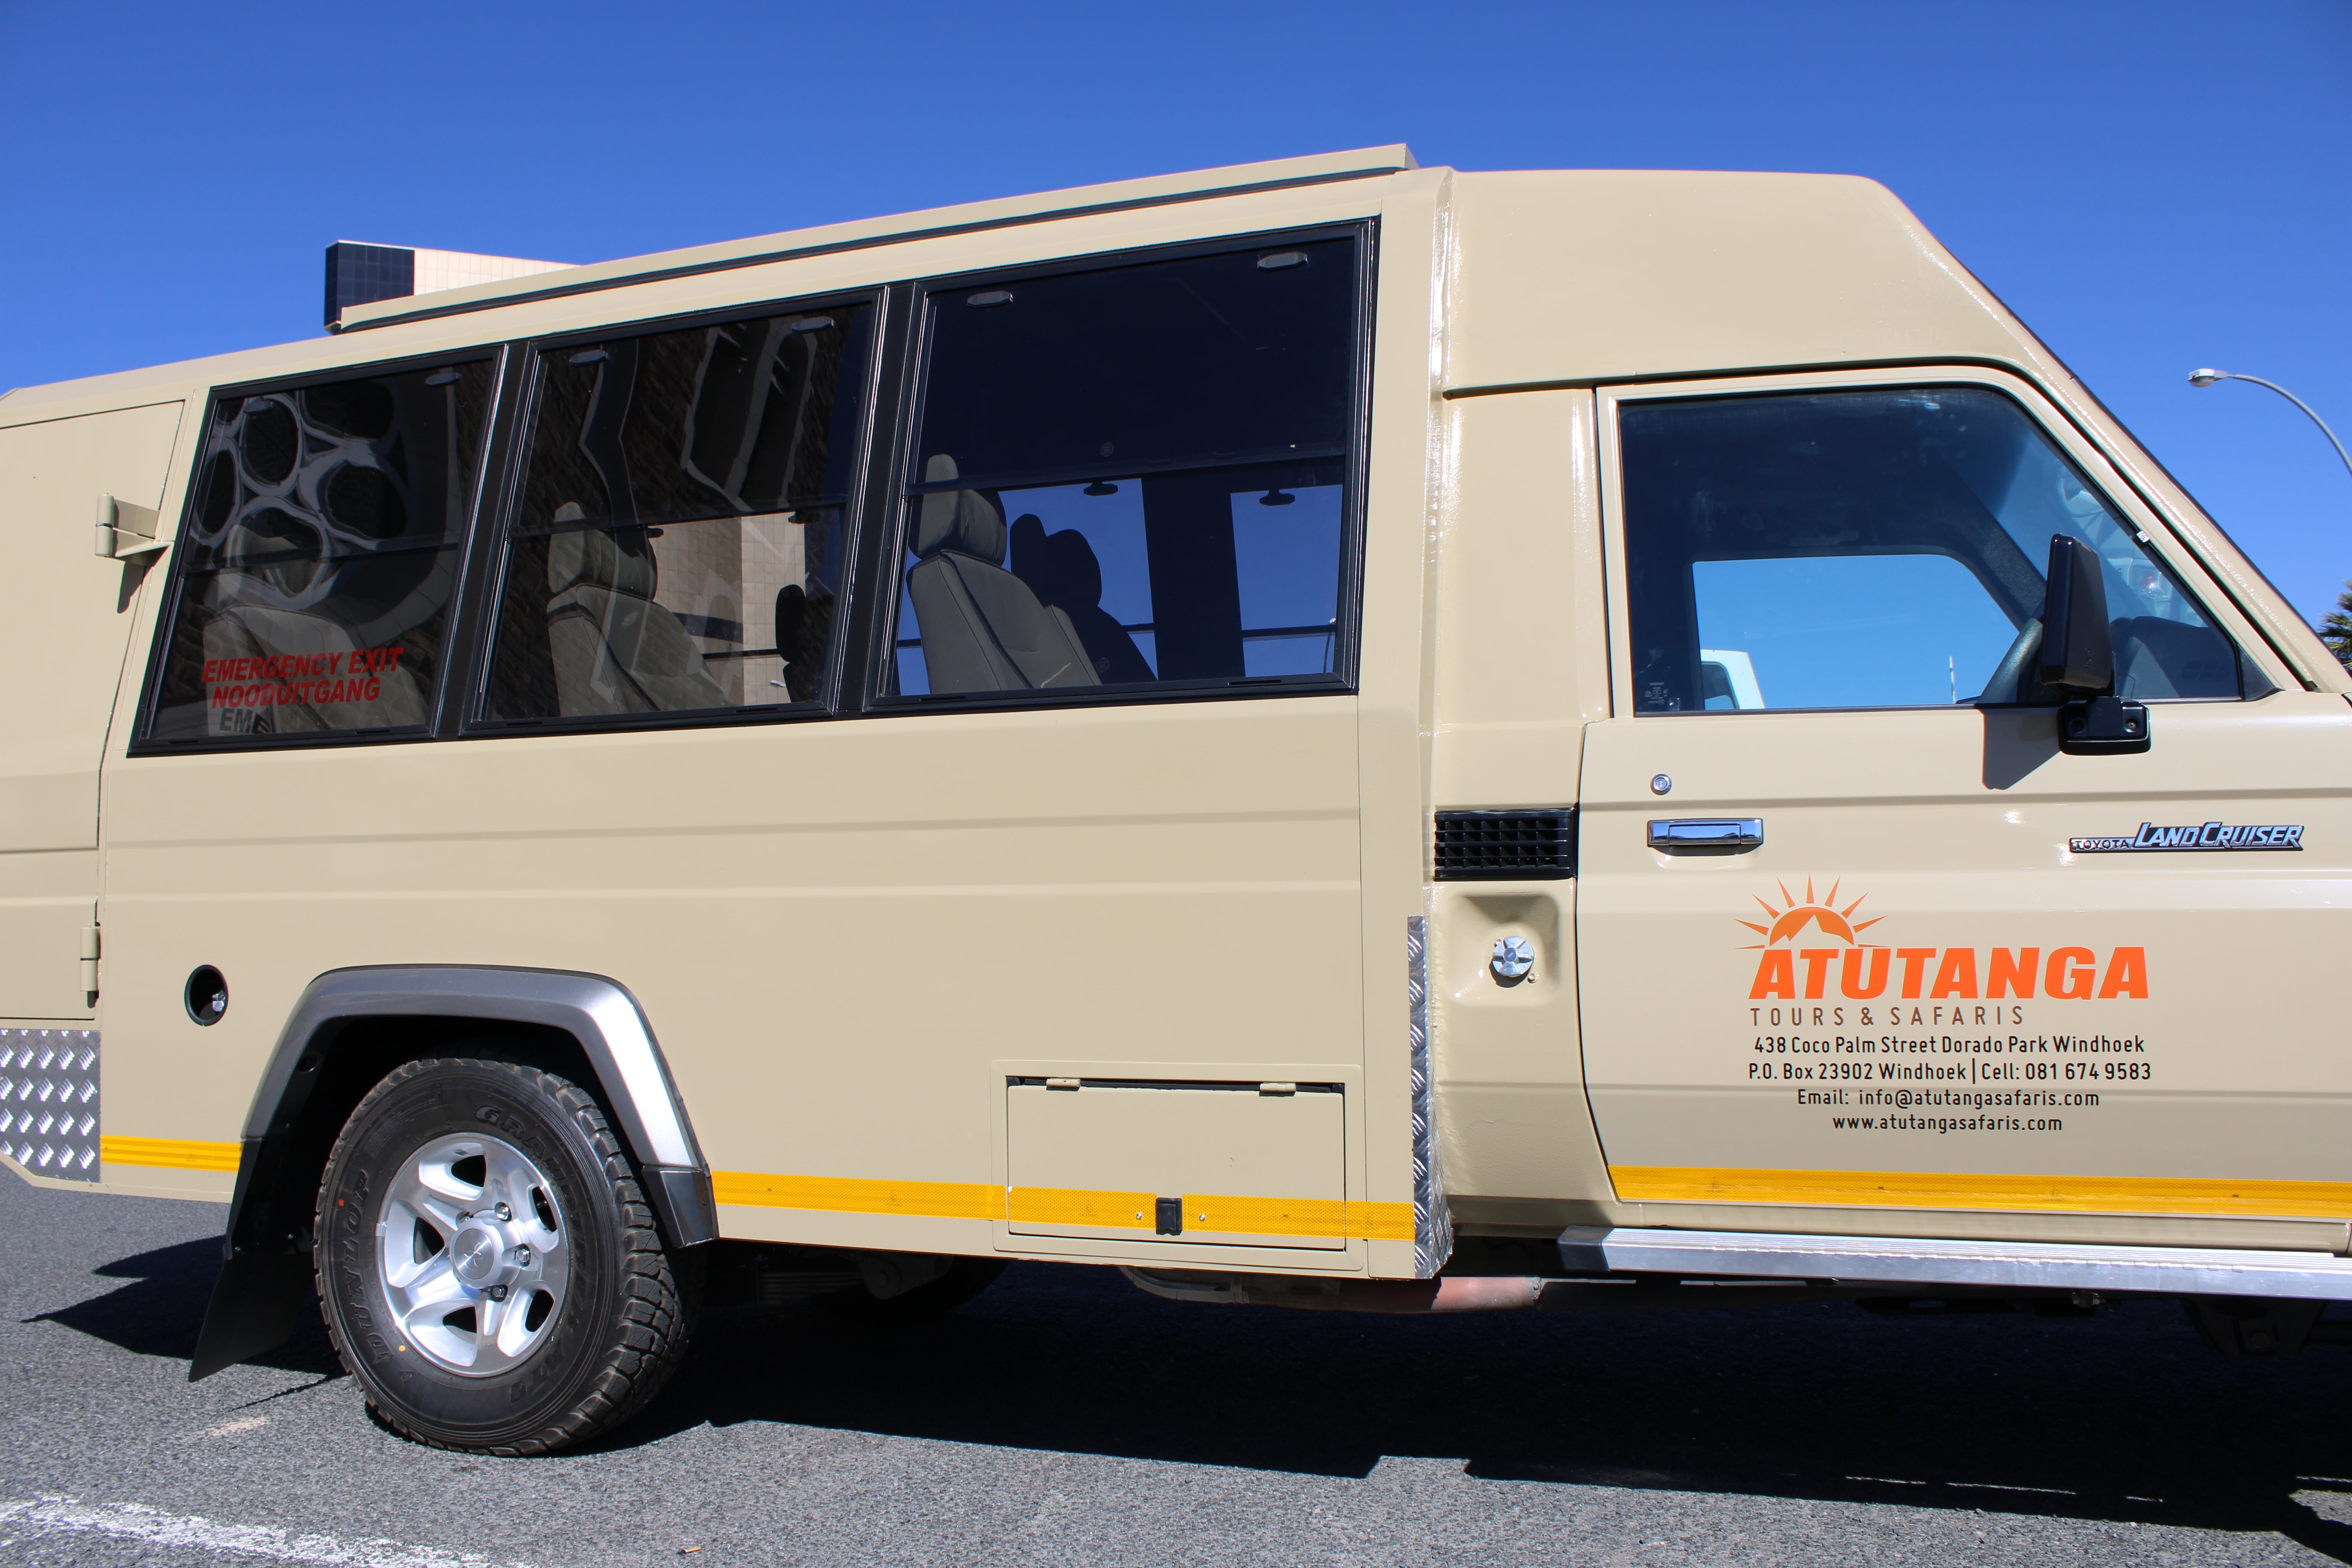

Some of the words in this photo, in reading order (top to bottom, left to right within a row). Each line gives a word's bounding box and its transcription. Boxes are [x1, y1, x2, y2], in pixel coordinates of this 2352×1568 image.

[201, 652, 343, 682] EMERGENCY
[347, 647, 404, 674] EXIT
[211, 677, 381, 708] NOODUITGANG
[2074, 839, 2129, 850] TOYOTA
[1748, 947, 2149, 1000] ATUTANGA
[1750, 1007, 1844, 1026] TOURS
[1861, 1007, 1874, 1026] &
[1890, 1005, 2023, 1025] SAFARIS
[1755, 1036, 1786, 1054] 438
[1792, 1036, 1829, 1053] Coco
[1836, 1036, 1875, 1053] Palm
[1881, 1036, 1936, 1053] Street
[1942, 1035, 2002, 1053] Dorado
[2009, 1036, 2048, 1053] Park
[2053, 1034, 2144, 1053] Windhoek
[1749, 1063, 1778, 1080] P.O.
[1783, 1063, 1813, 1080] Box
[1818, 1063, 1873, 1080] 23902
[1878, 1062, 1966, 1080] Windhoek
[1982, 1062, 2020, 1080] Cell:
[2025, 1063, 2056, 1080] 081
[2065, 1063, 2100, 1080] 674
[2105, 1063, 2151, 1080] 9583
[1798, 1089, 1849, 1105] Email:
[1859, 1089, 2099, 1110] info@atutangasafaris.com
[1833, 1114, 2062, 1134] www.atutangasafaris.com
[346, 1169, 393, 1365] DUNLOP
